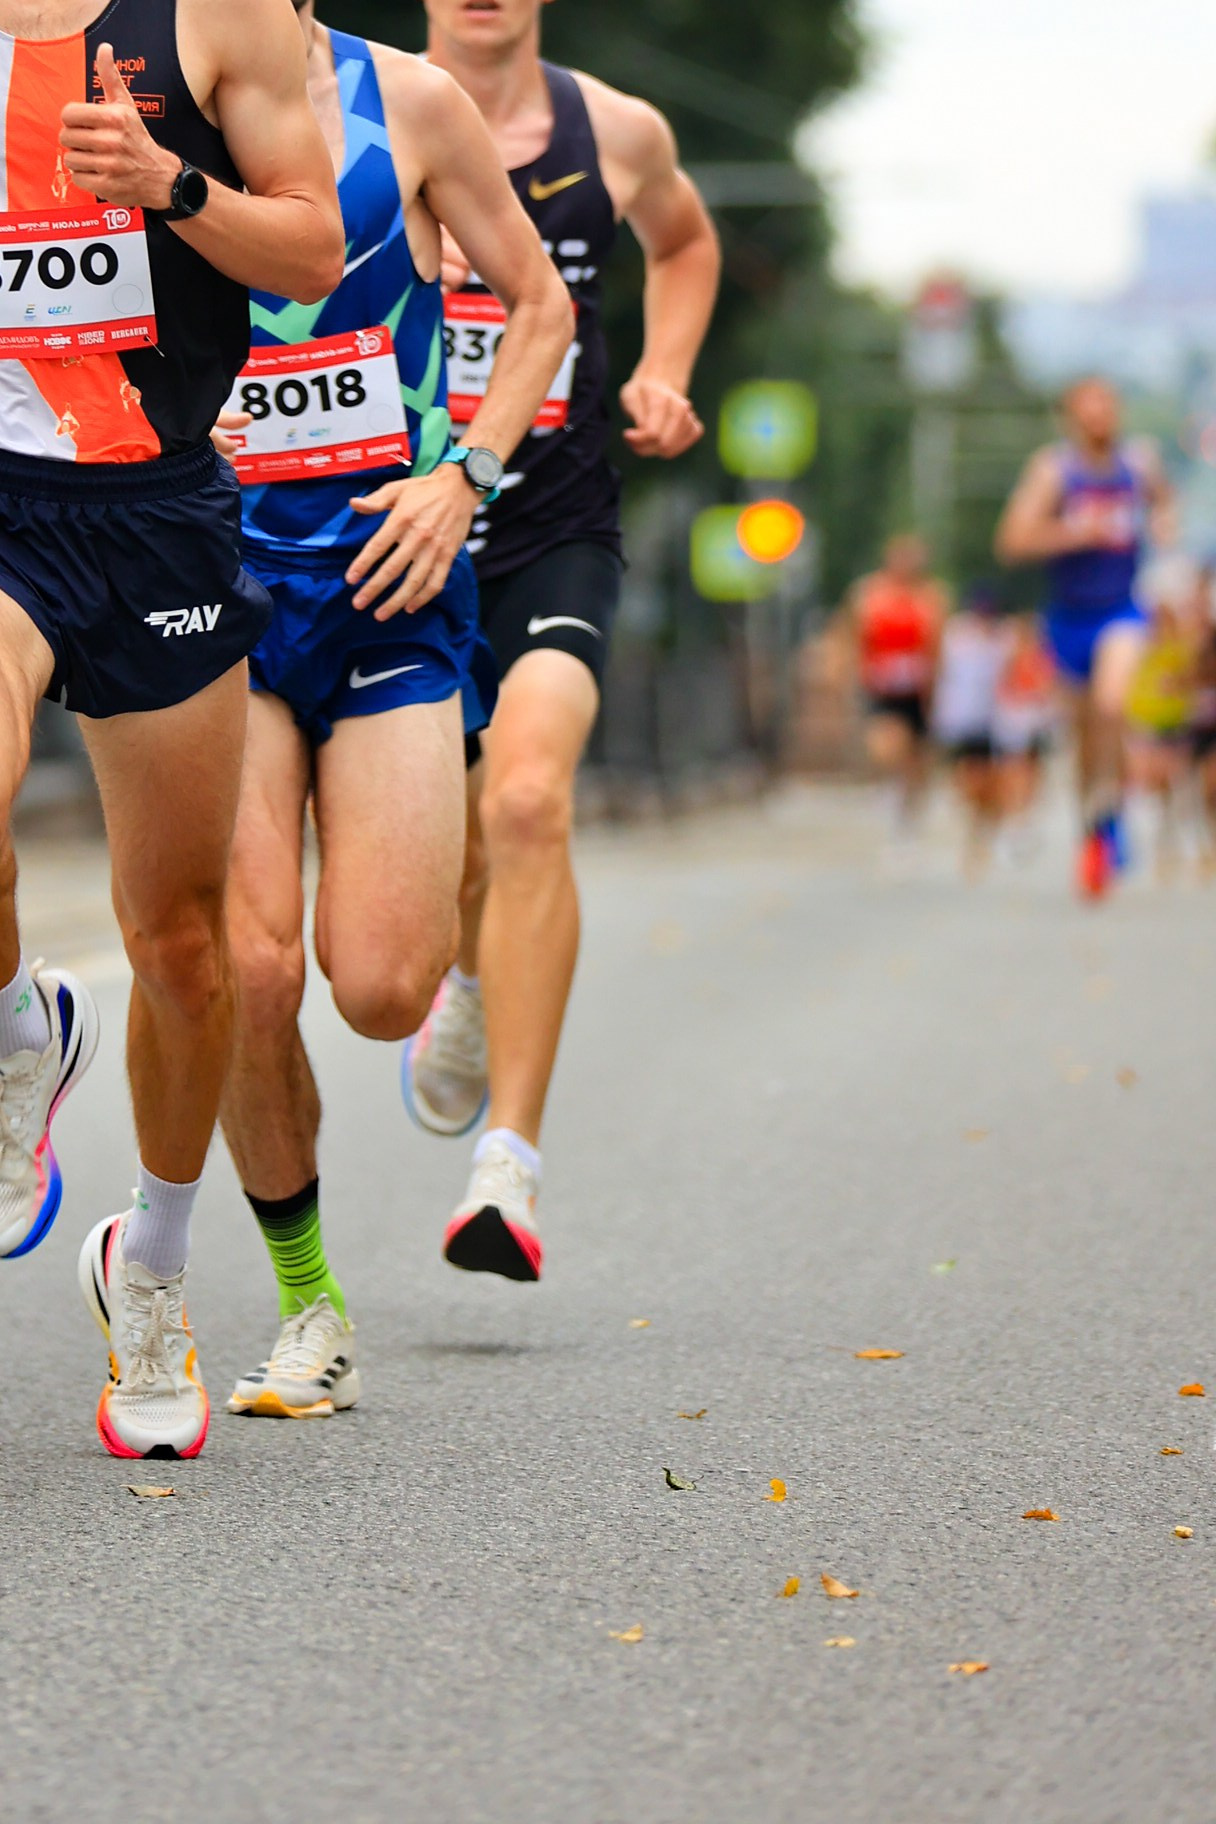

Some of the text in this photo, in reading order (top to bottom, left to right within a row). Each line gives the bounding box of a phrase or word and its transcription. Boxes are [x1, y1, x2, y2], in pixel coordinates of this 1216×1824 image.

[51, 219, 81, 229] ИЮЛЬ
[102, 208, 131, 230] 10
[241, 368, 366, 420] 8018
[144, 604, 223, 638] RAY
